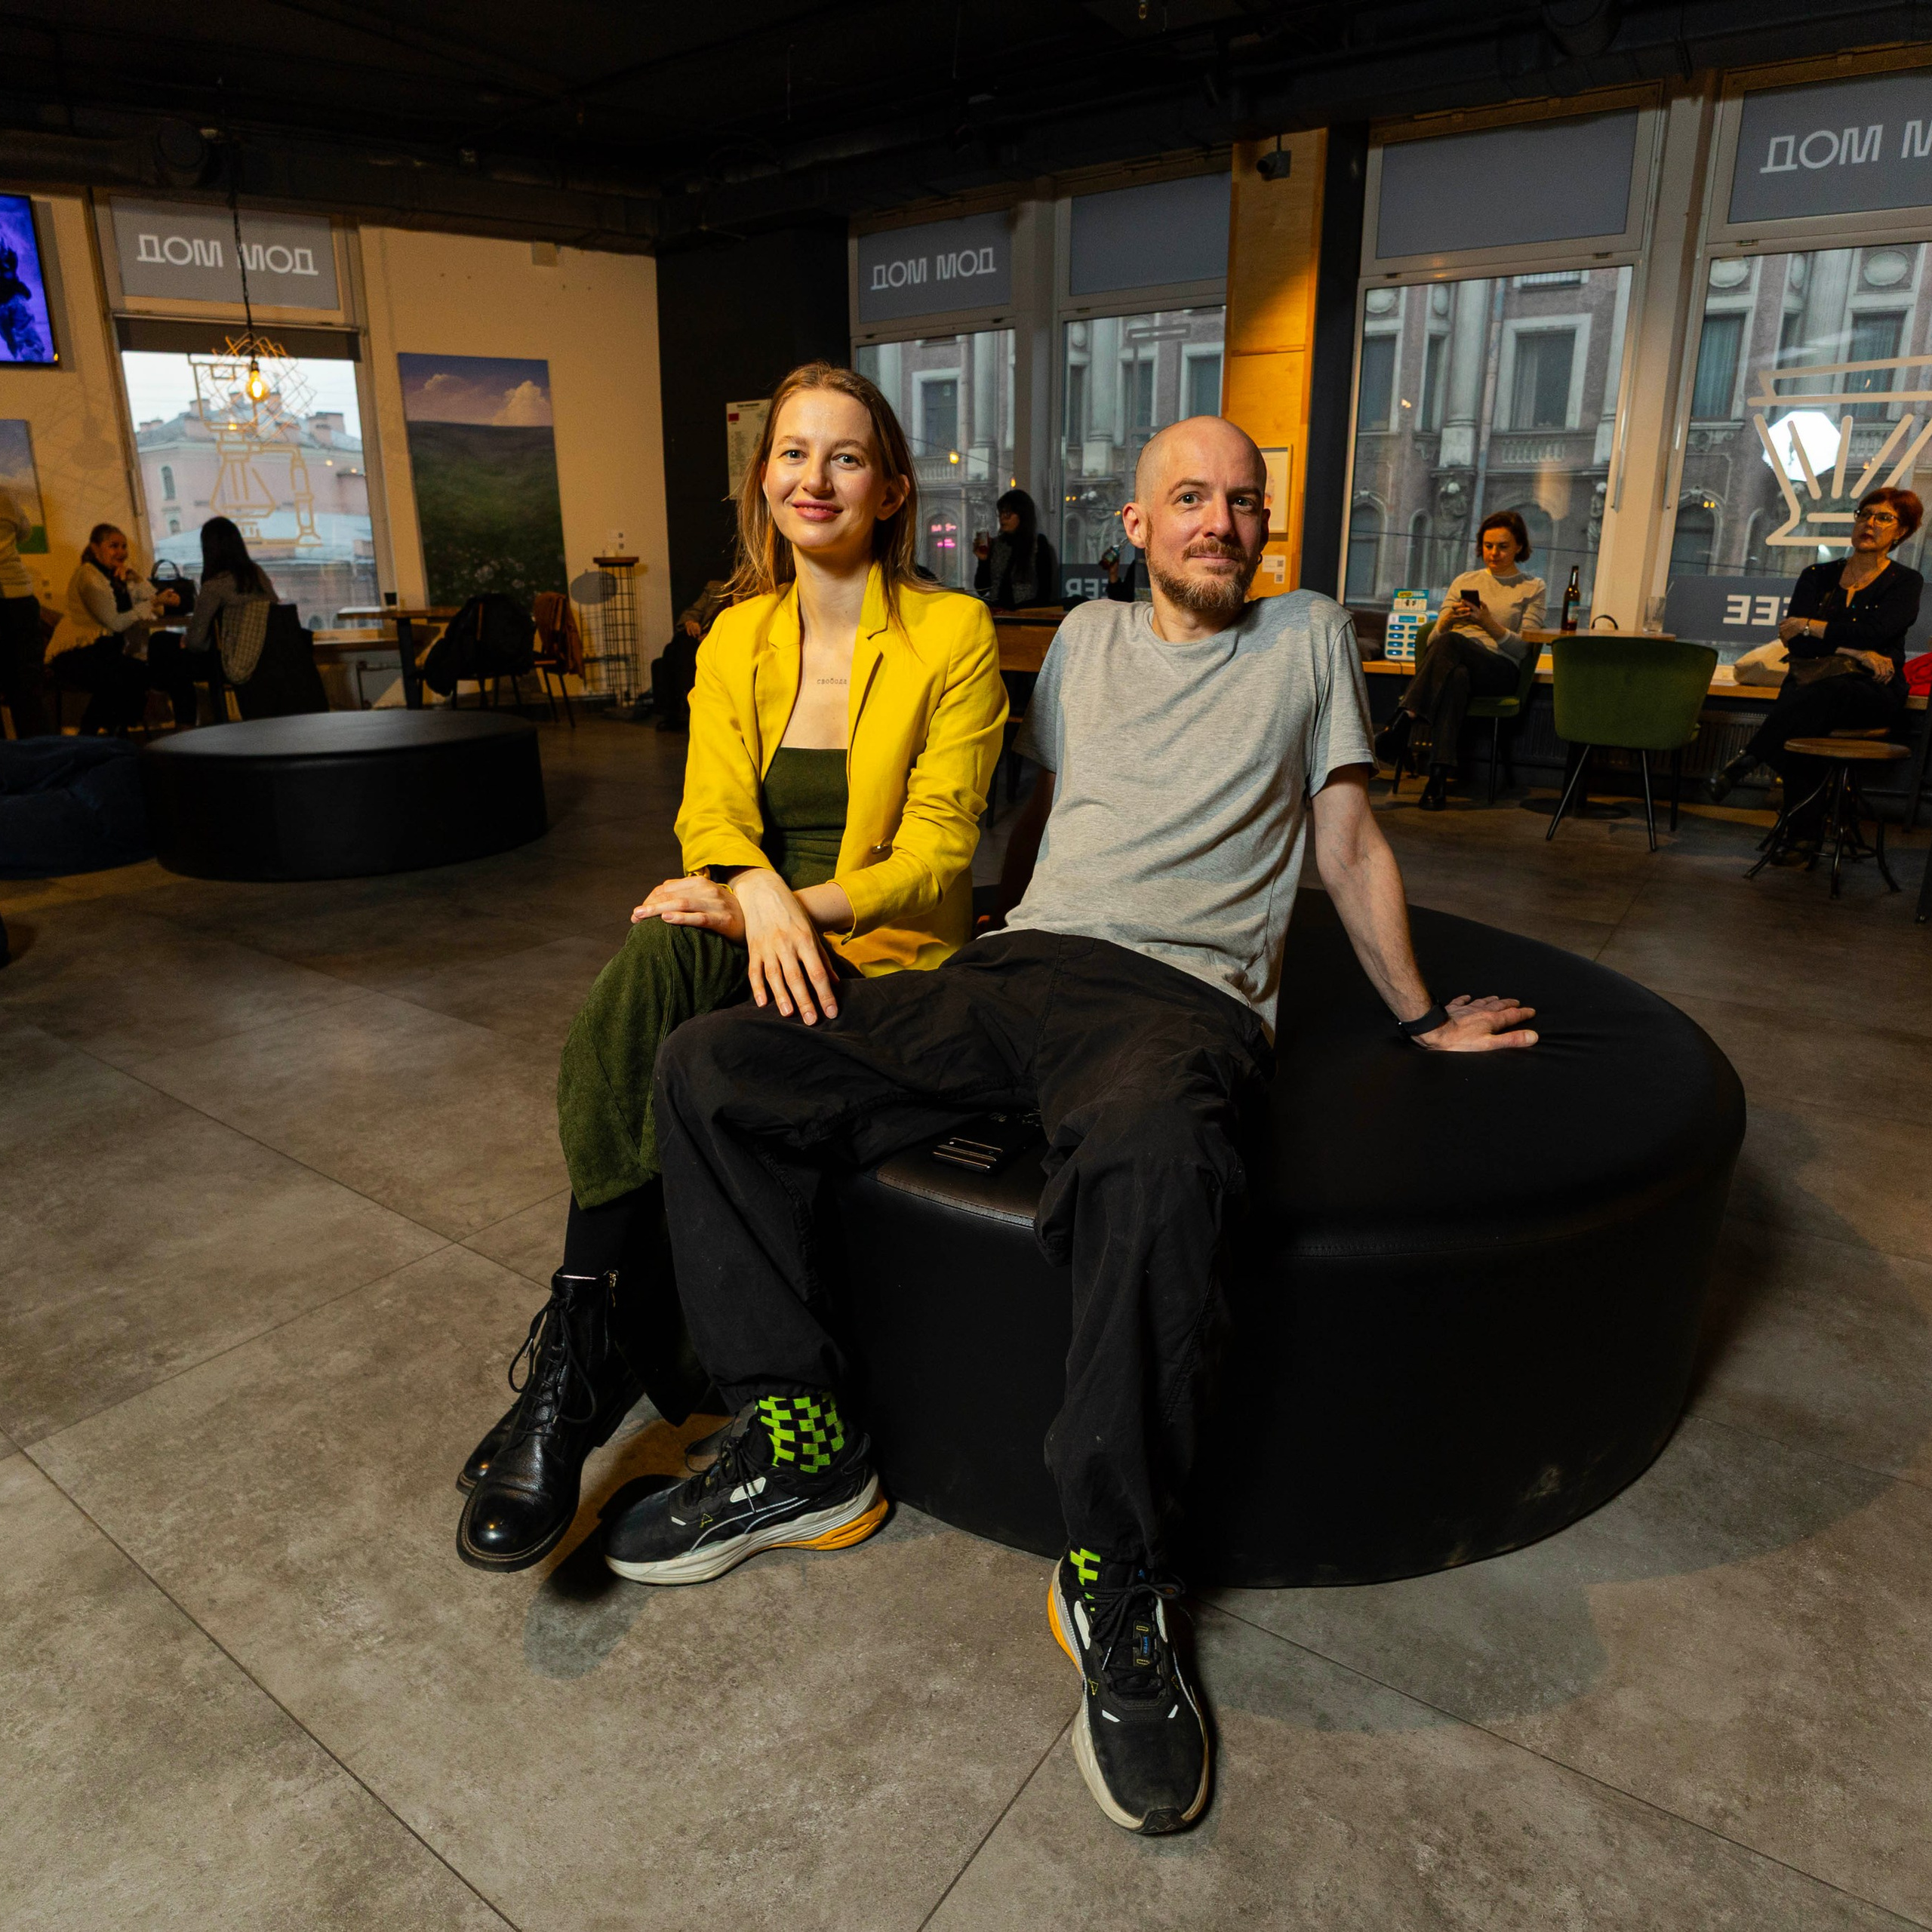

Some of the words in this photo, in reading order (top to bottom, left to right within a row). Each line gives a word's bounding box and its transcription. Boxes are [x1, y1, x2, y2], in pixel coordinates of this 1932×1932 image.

[1759, 125, 1884, 174] ДОМ
[137, 234, 224, 267] ДОМ
[238, 243, 319, 276] МОД
[870, 257, 927, 291] ДОМ
[937, 248, 996, 280] МОД
